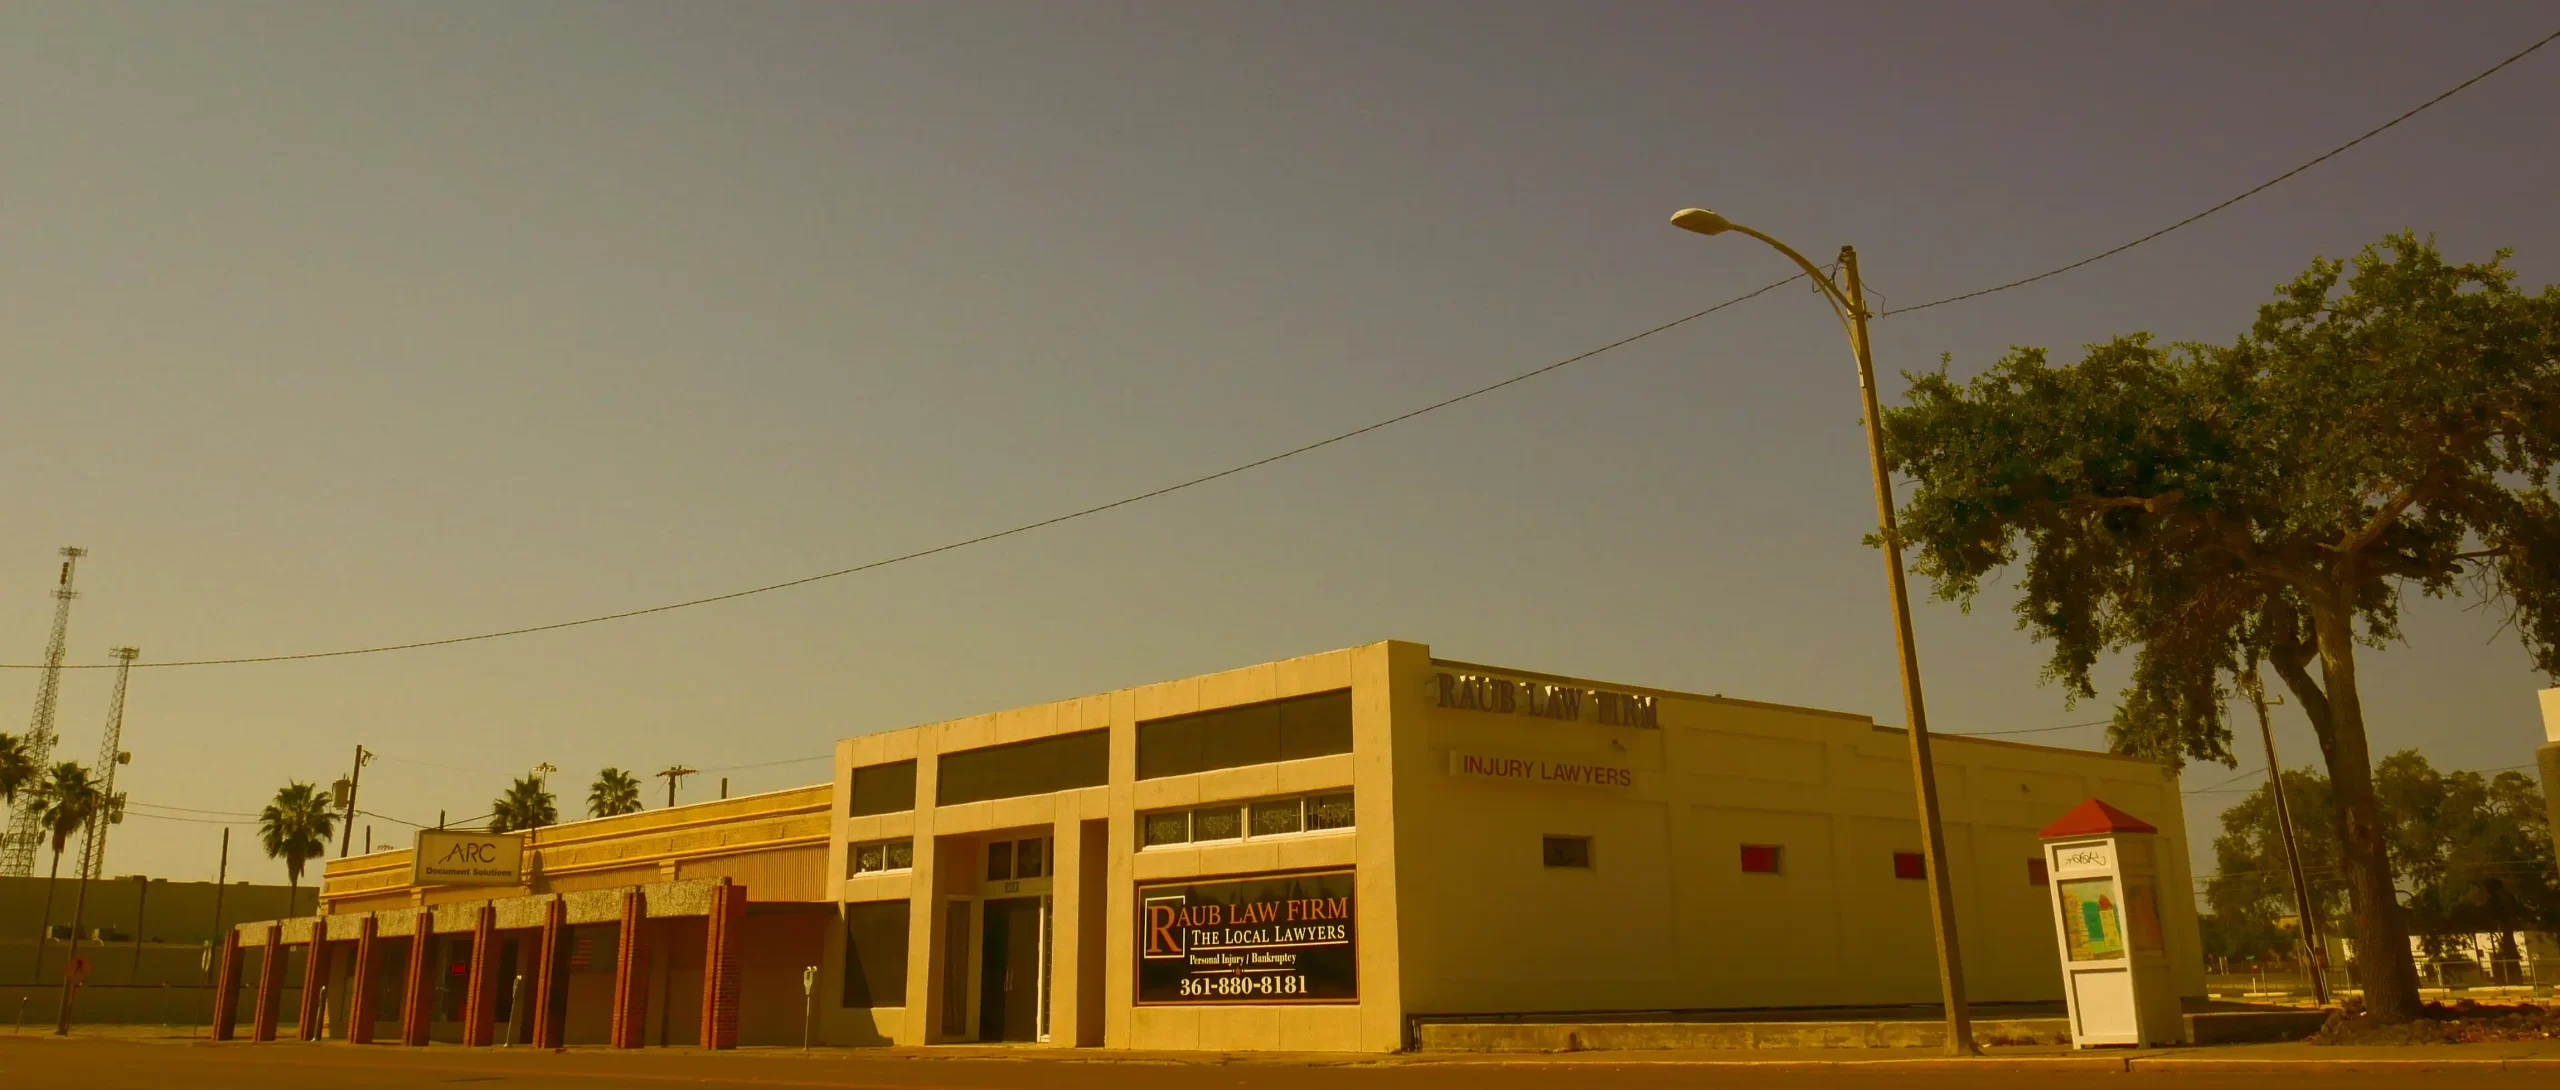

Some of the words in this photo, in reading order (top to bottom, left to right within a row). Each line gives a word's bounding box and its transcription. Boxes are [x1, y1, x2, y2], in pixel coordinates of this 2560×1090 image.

[1436, 673, 1516, 714] RAUB
[1526, 682, 1583, 721] LAW
[1595, 690, 1660, 730] FIRM
[1464, 755, 1534, 778] INJURY
[1541, 763, 1631, 786] LAWYERS
[438, 842, 497, 864] ARC
[426, 867, 470, 876] Document
[473, 868, 512, 877] Solutions
[1147, 904, 1221, 953] RAUB
[1229, 901, 1280, 924] LAW
[1287, 897, 1348, 921] FIRM
[1192, 929, 1219, 945] THE
[1225, 928, 1270, 944] LOCAL
[1275, 924, 1345, 942] LAWYERS
[1190, 953, 1220, 965] Personal
[1221, 953, 1244, 966] Injury
[1251, 952, 1297, 965] Bankruptcy
[1180, 975, 1308, 996] 361-880-8181
